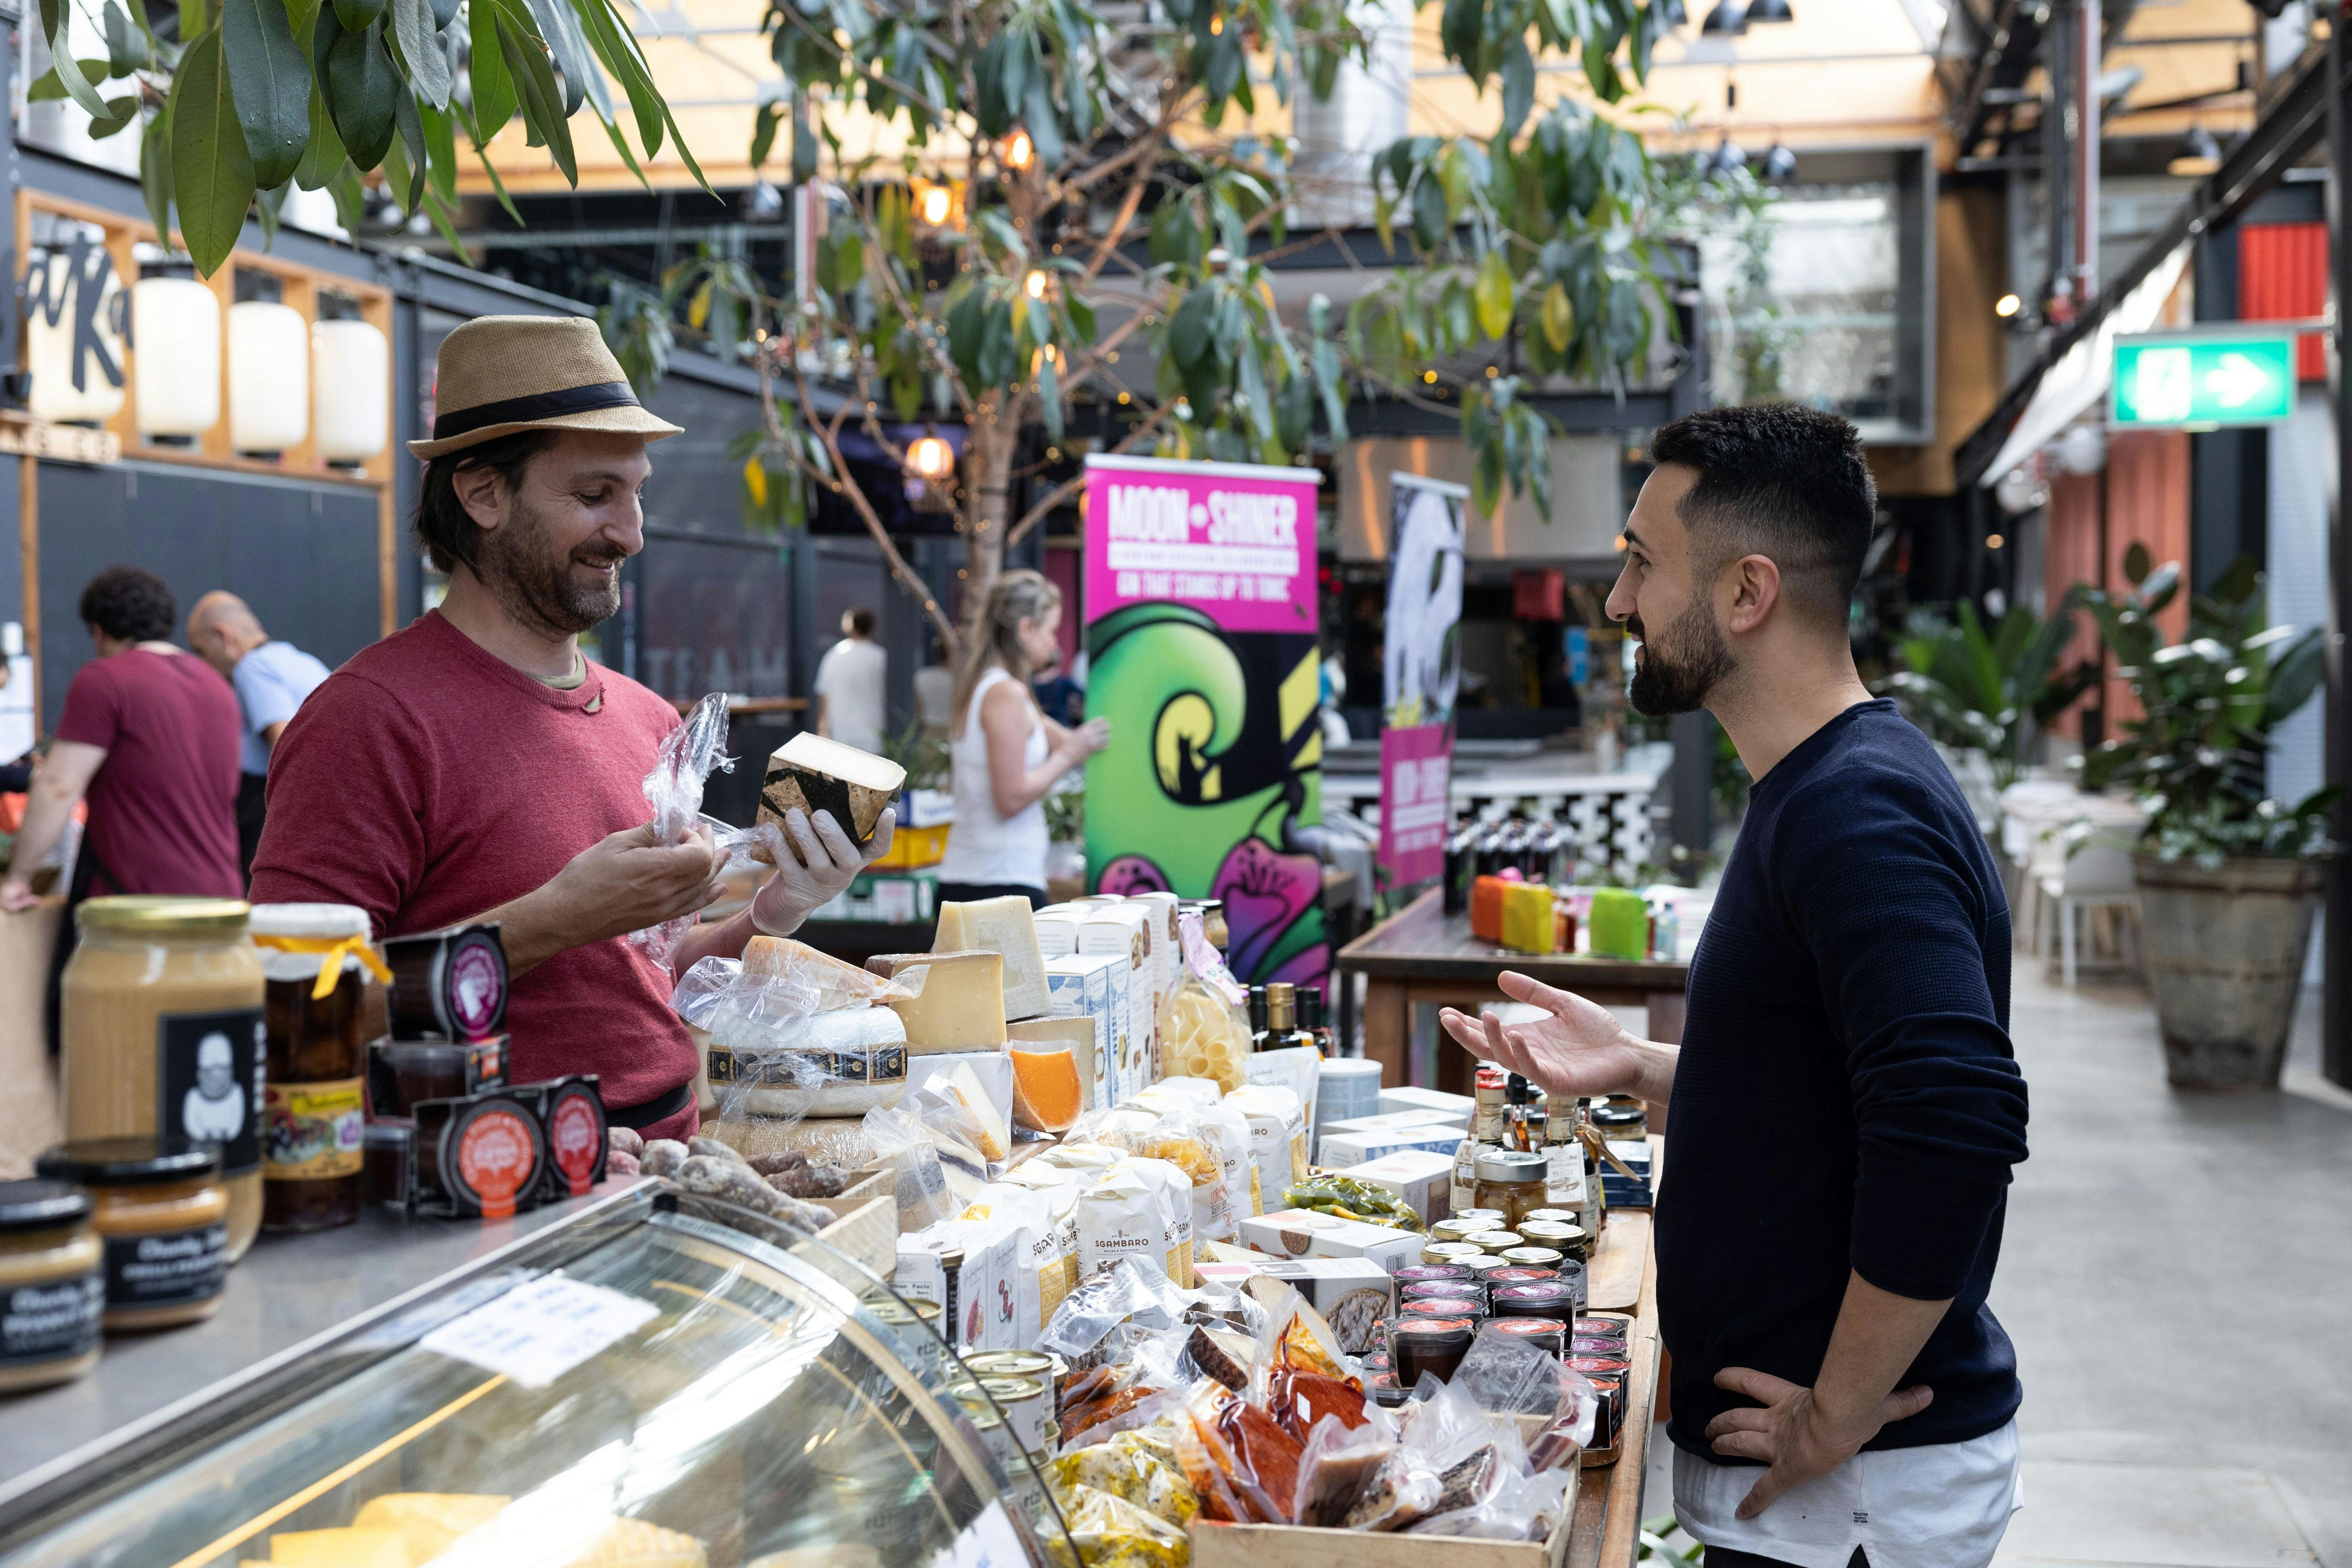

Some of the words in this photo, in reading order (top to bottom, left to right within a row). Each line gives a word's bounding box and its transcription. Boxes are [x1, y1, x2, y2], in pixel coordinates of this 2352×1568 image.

[1108, 484, 1189, 542] MOON
[1207, 490, 1298, 546] SHINER
[1095, 1239, 1148, 1247] SGAMBARO
